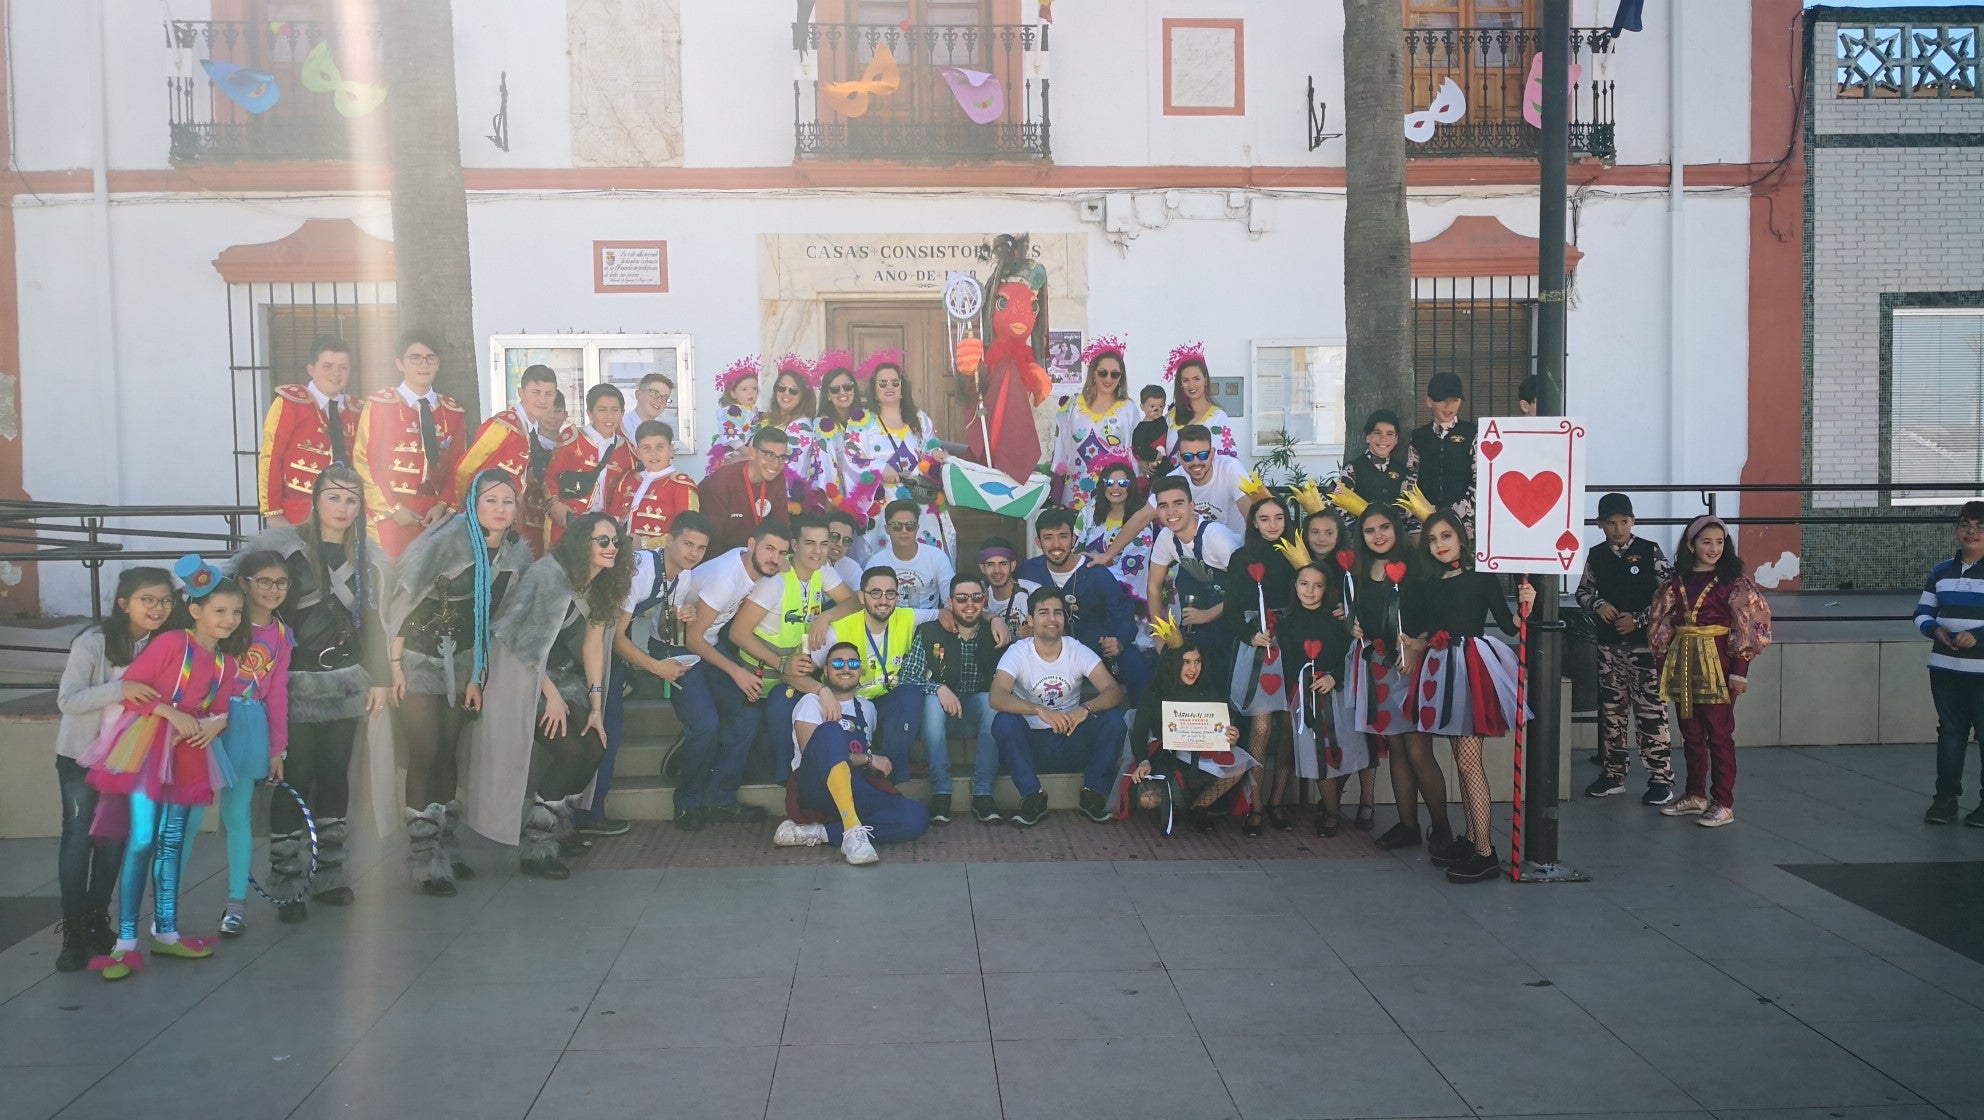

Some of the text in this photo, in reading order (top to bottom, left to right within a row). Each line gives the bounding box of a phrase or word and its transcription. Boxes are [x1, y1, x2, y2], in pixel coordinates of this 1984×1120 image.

[806, 245, 1042, 259] CASAS CONSISTORIS
[873, 263, 977, 282] AÑO DE 18
[1484, 419, 1501, 439] A
[1557, 552, 1576, 571] A
